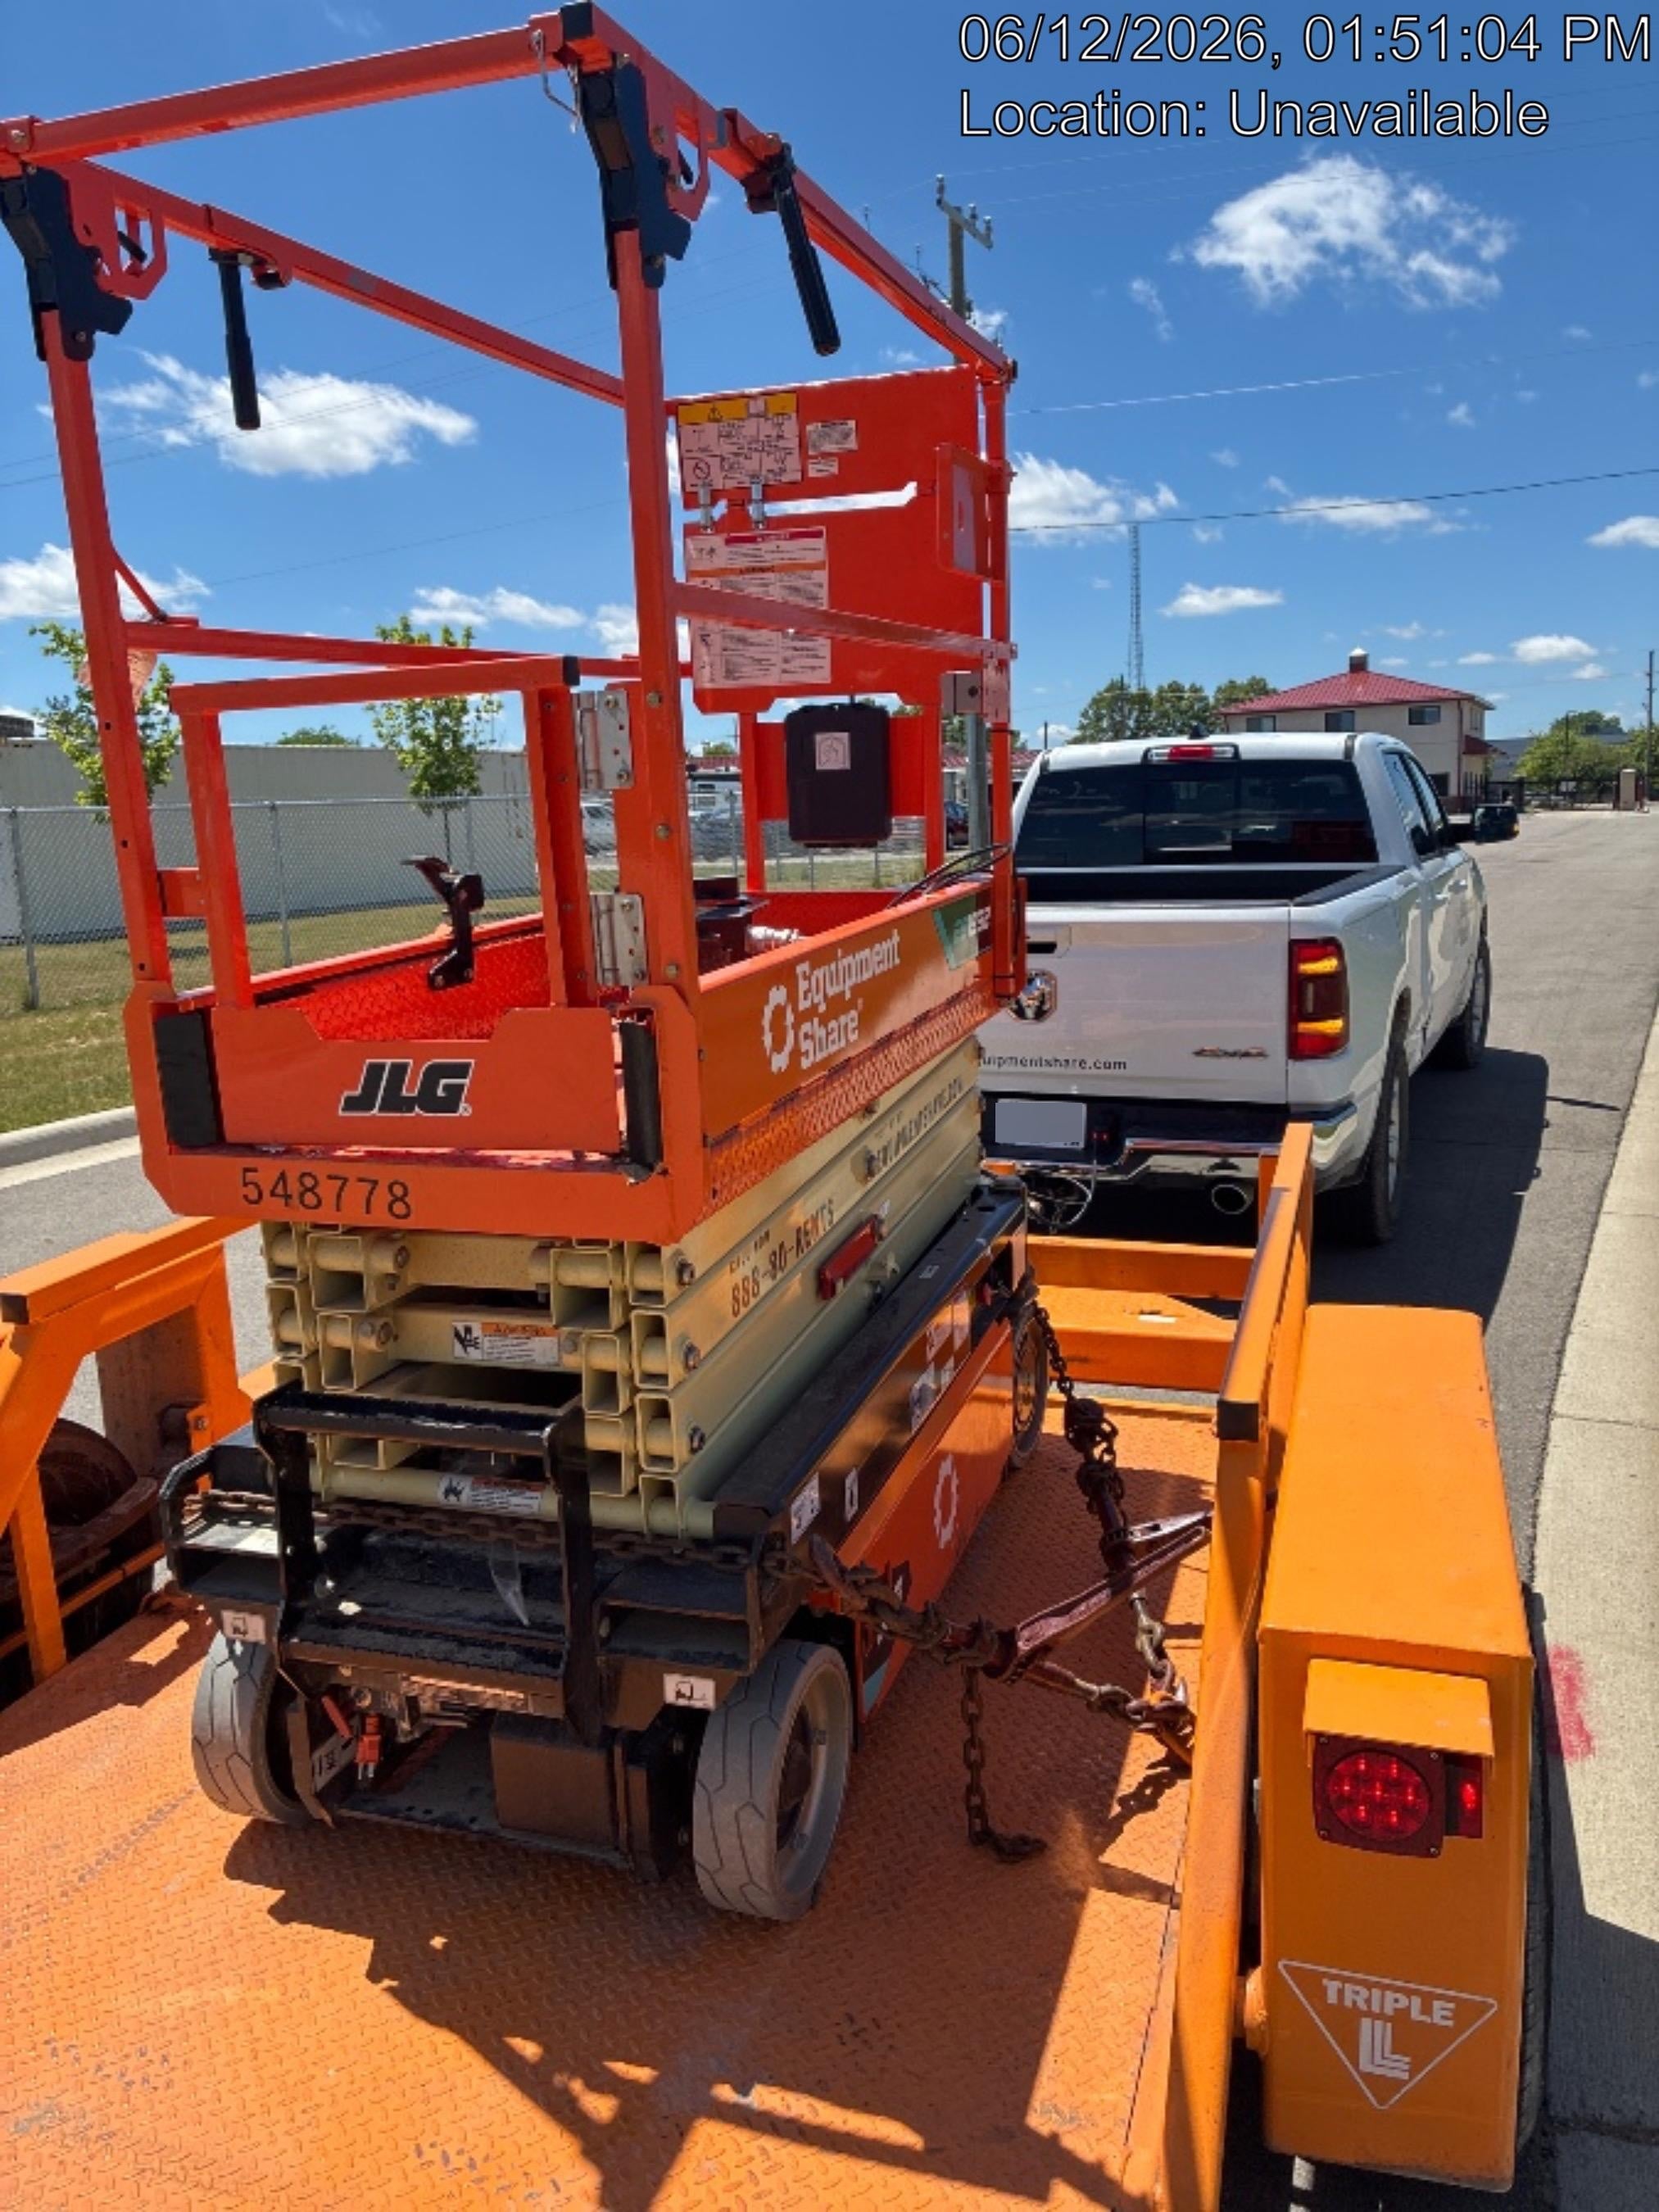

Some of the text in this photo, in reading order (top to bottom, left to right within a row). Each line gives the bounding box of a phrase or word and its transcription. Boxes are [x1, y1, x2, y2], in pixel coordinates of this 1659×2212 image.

[795, 928, 900, 1013] Equipment
[799, 1012, 859, 1069] Share
[977, 1054, 1127, 1072] uipmentshare.com
[338, 1059, 475, 1116] JLG
[241, 1167, 412, 1220] 548778
[1321, 1978, 1456, 2028] TRIPLE
